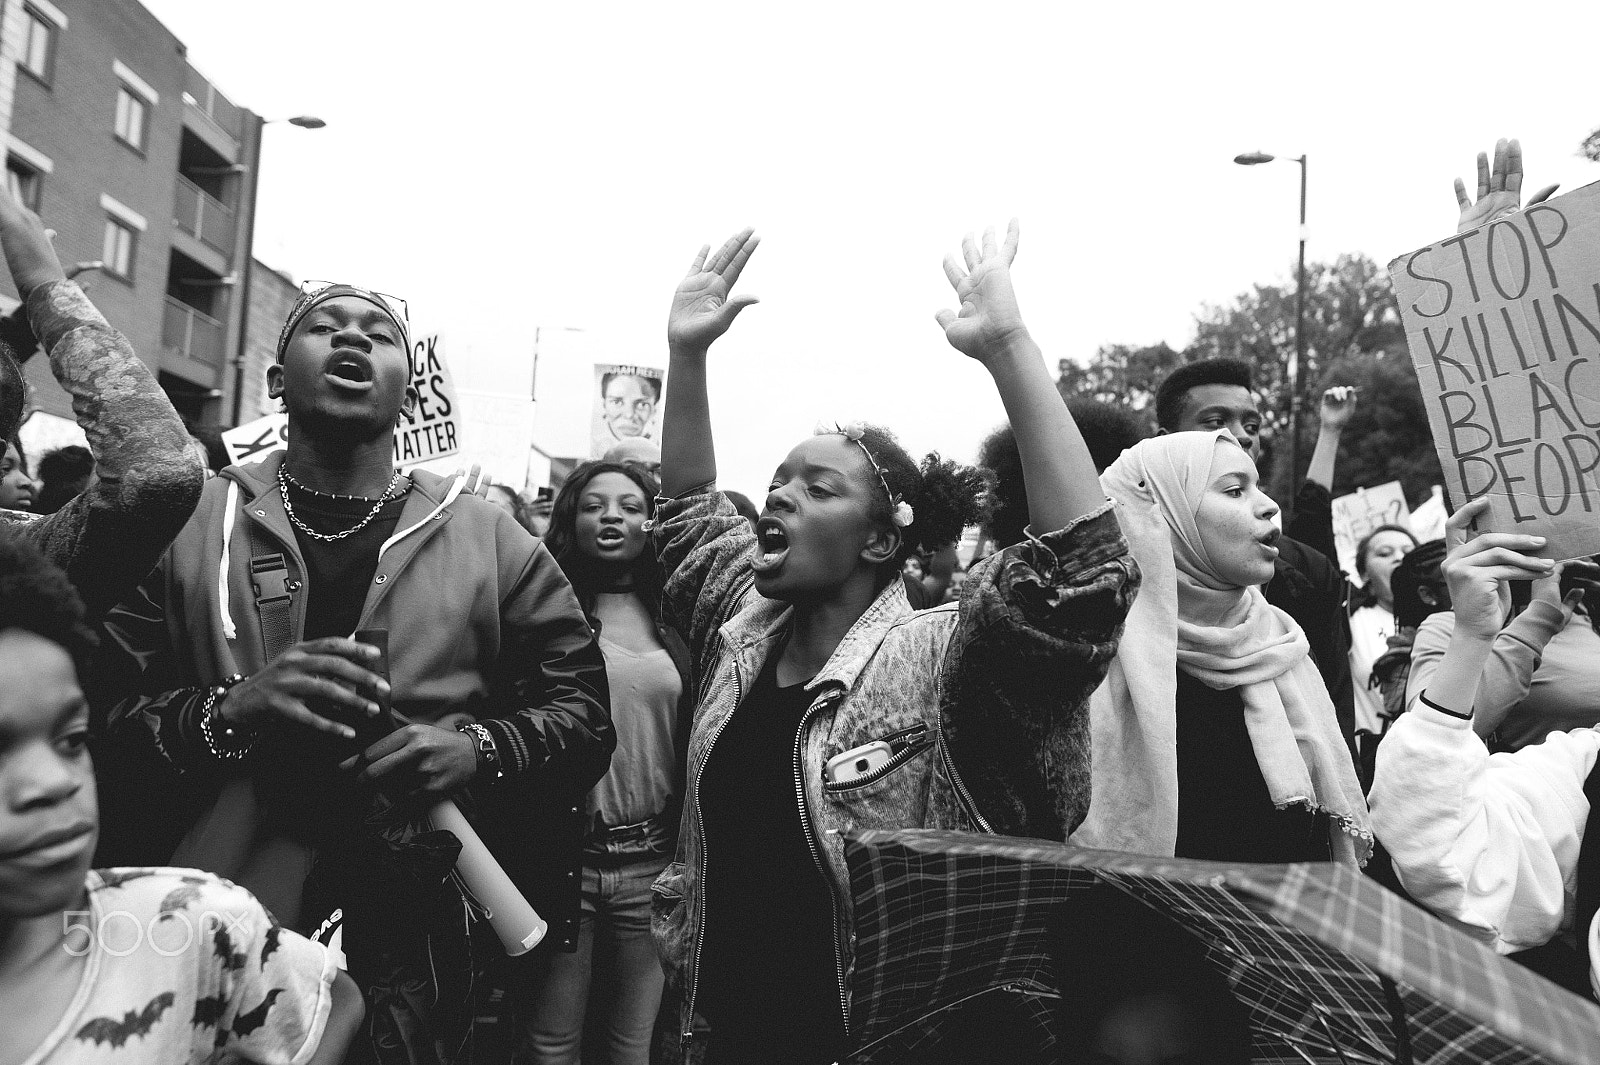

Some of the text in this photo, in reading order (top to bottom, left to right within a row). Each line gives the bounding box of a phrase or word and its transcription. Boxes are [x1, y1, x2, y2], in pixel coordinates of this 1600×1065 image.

[1406, 206, 1568, 318] STOP
[1423, 282, 1600, 392] KILLIN
[1438, 357, 1600, 460] BLAC
[1457, 431, 1600, 532] PEOP
